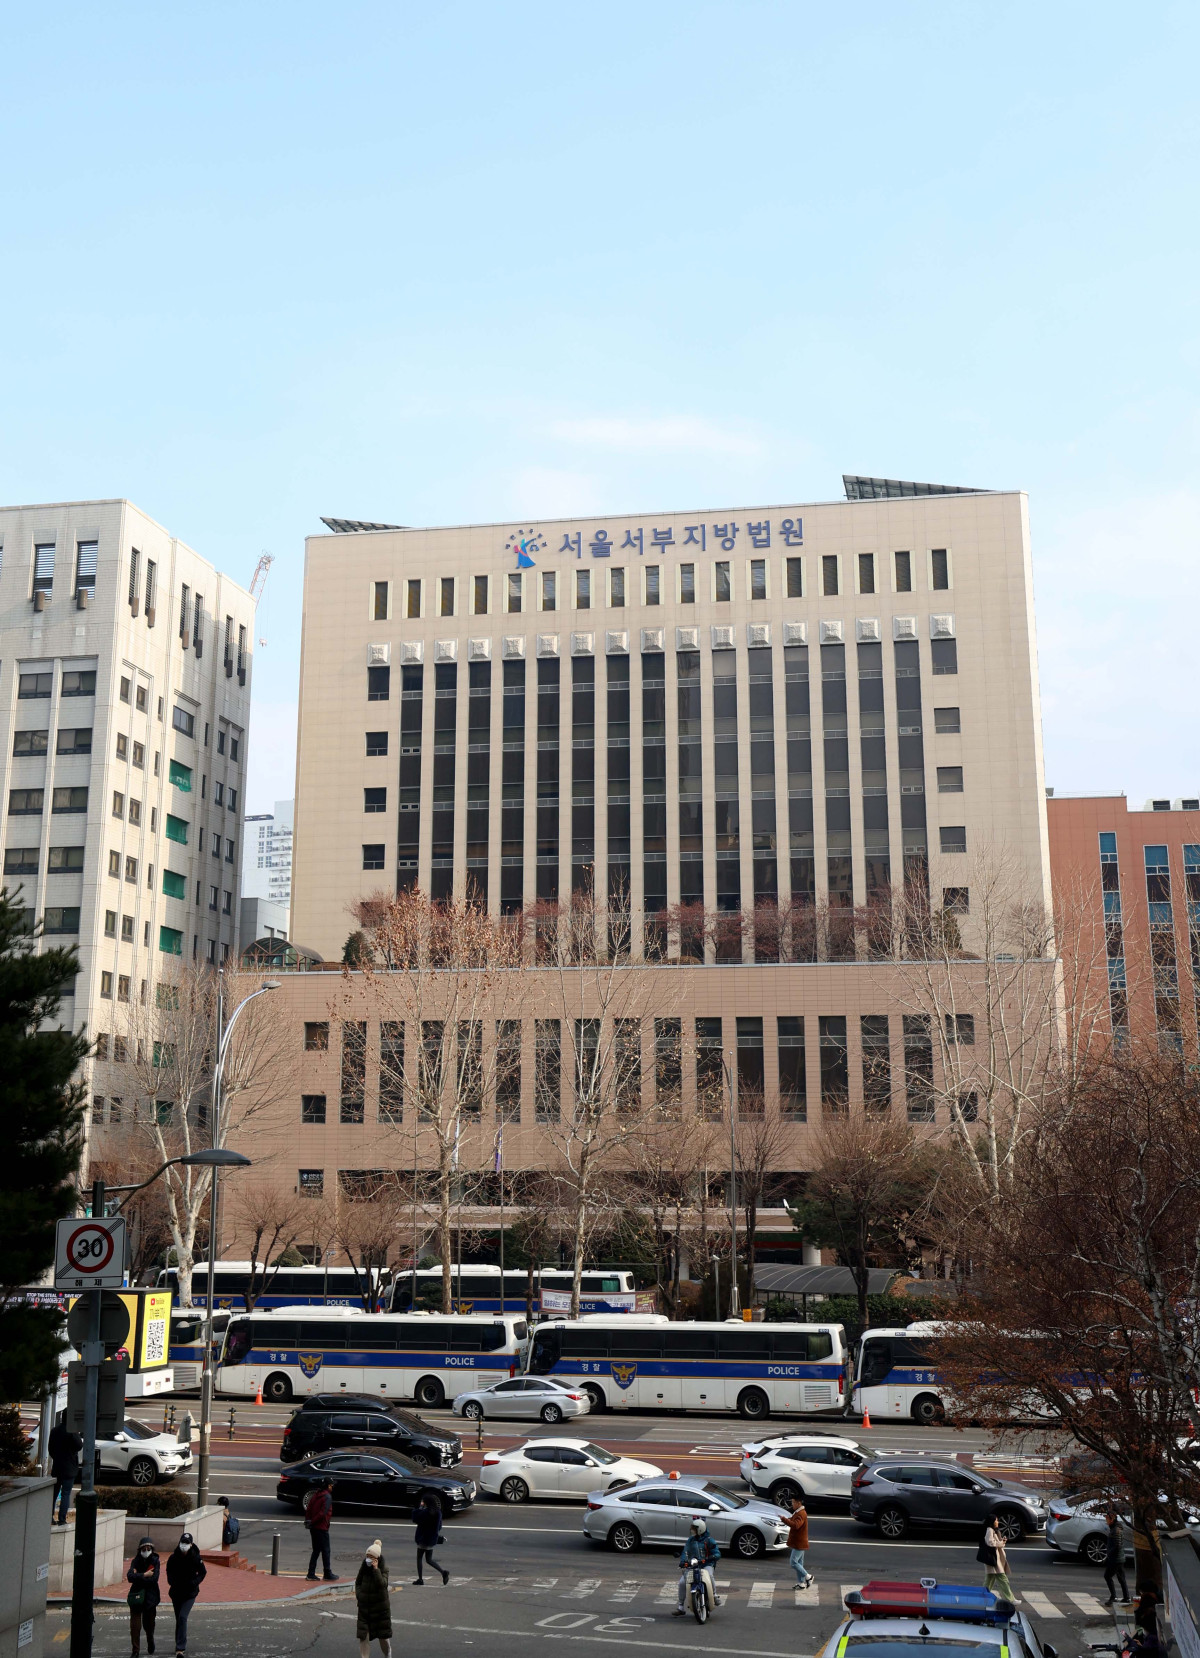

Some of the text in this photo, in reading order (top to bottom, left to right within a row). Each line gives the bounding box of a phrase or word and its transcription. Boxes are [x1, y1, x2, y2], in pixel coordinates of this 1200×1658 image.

[559, 518, 804, 558] 서울서부지방법원
[78, 1238, 103, 1258] 30
[445, 1357, 475, 1366] POLICE
[768, 1366, 800, 1375] POLICE
